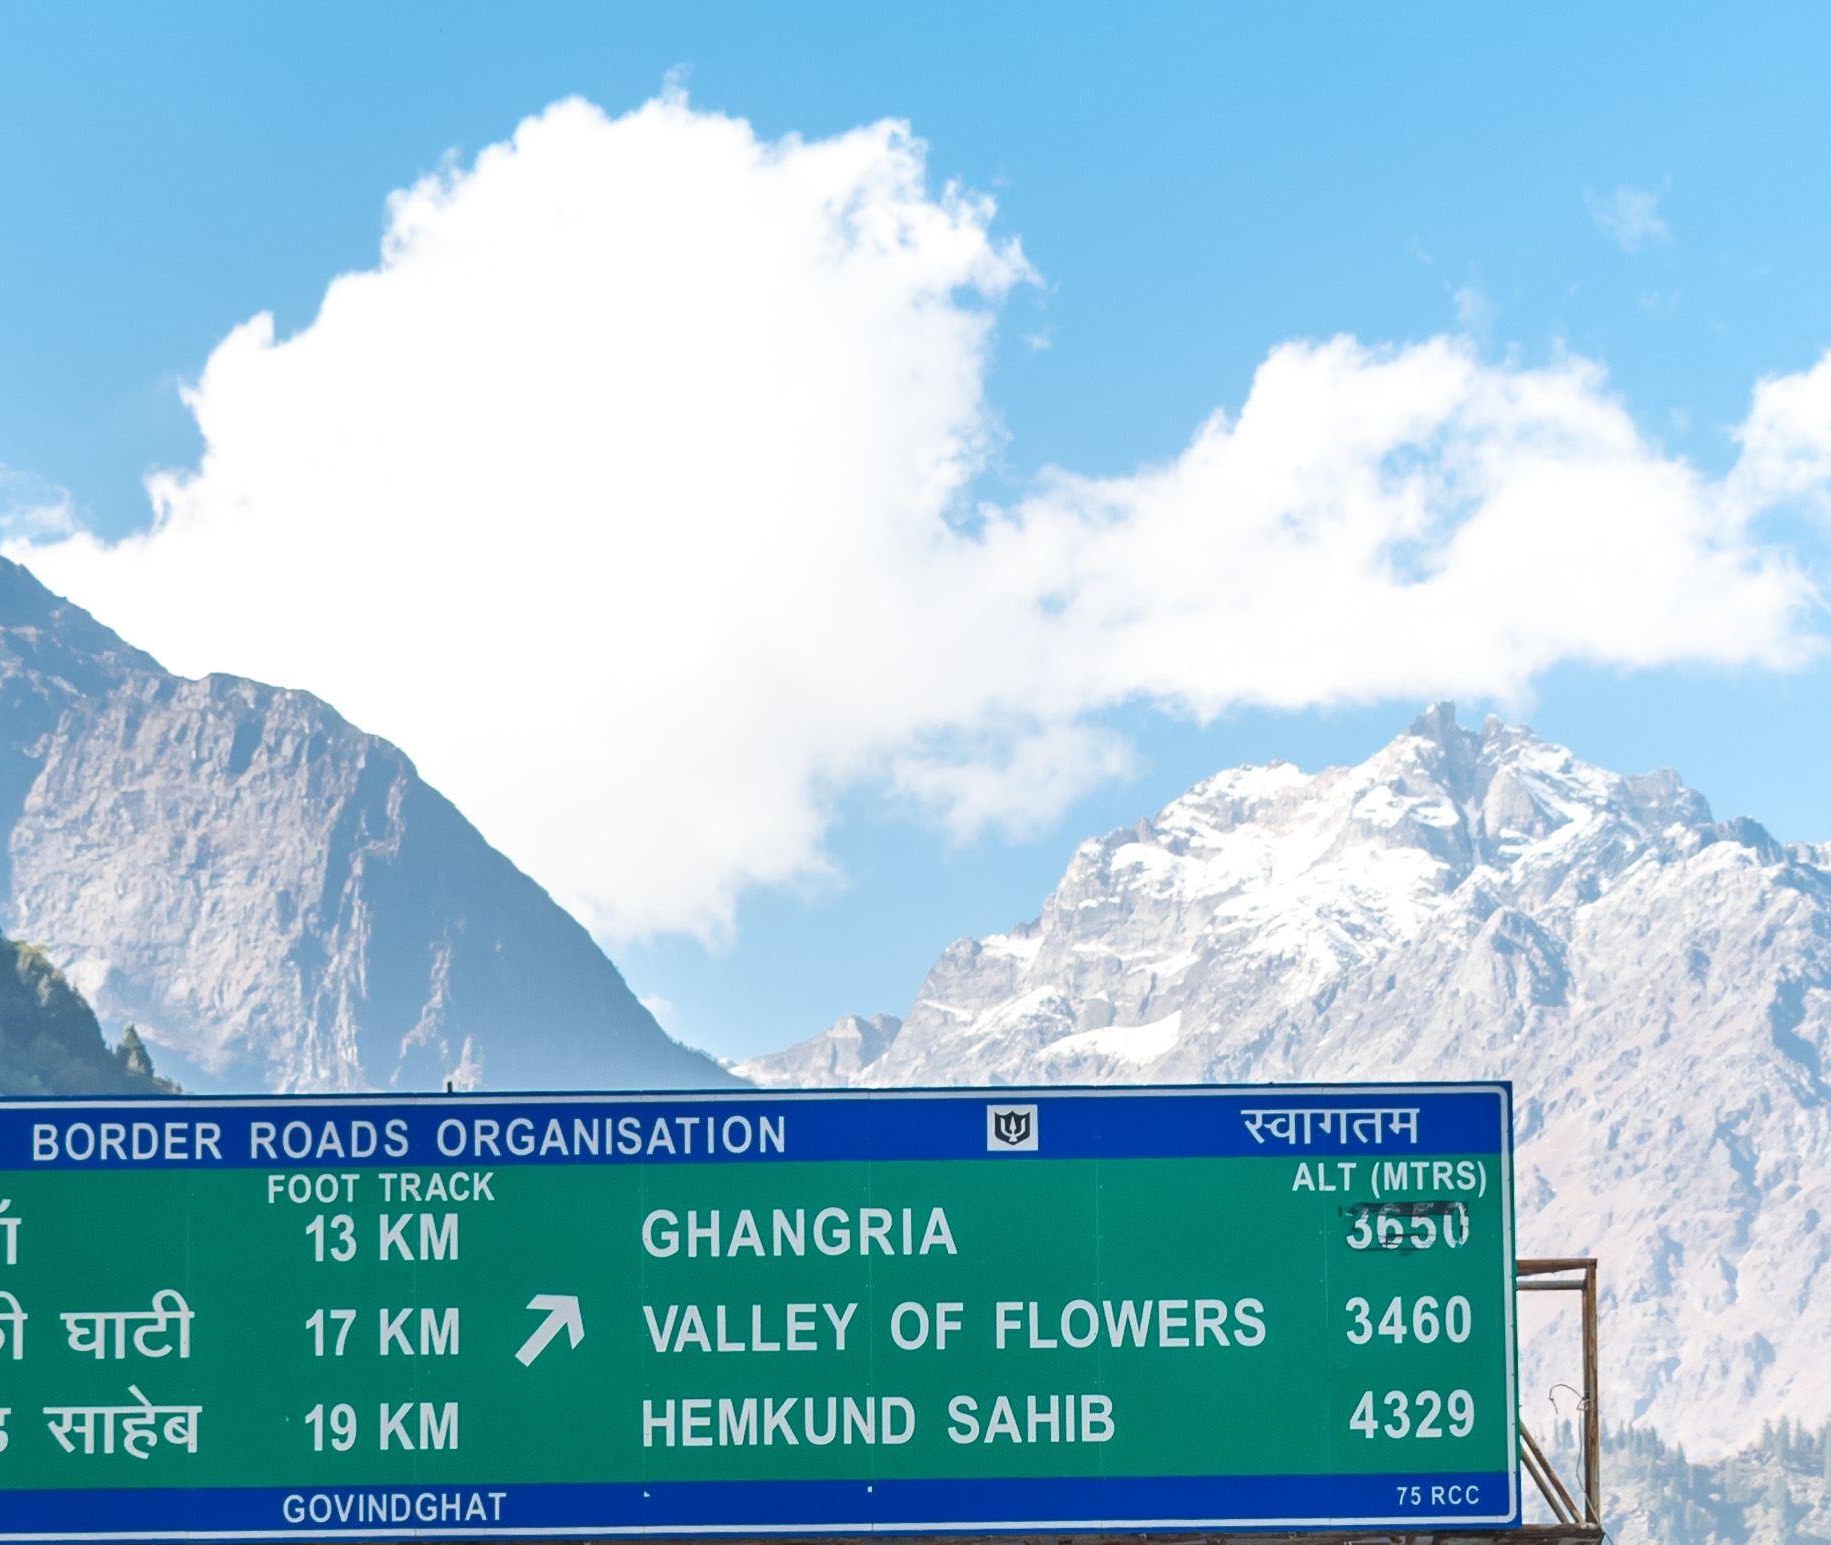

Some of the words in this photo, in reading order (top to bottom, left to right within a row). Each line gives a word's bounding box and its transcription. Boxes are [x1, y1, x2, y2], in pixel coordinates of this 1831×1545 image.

[33, 1122, 222, 1161] BORDER
[250, 1119, 409, 1159] ROADS
[437, 1115, 785, 1157] ORGANISATION
[1240, 1108, 1420, 1145] स्वागतम
[268, 1173, 360, 1204] FOOT
[378, 1171, 495, 1202] TRACK
[1292, 1162, 1357, 1192] ALT
[1371, 1160, 1487, 1199] (MTRS)
[305, 1214, 357, 1262] 13
[379, 1213, 459, 1261] KM
[642, 1206, 958, 1258] GHANGRIA
[59, 1288, 195, 1360] घाटी
[305, 1309, 357, 1357] 17
[379, 1307, 460, 1356] KM
[642, 1302, 858, 1353] VALLEY
[890, 1301, 964, 1351] OF
[996, 1297, 1266, 1349] FLOWERS
[1345, 1295, 1472, 1345] 3460
[42, 1384, 203, 1460] साहेब
[305, 1403, 357, 1452] 19
[379, 1402, 459, 1451] KM
[642, 1396, 916, 1447] HEMKUND
[947, 1394, 1115, 1444] SAHIB
[1349, 1389, 1475, 1439] 4329
[283, 1492, 507, 1524] GOVINDGHAT
[1396, 1486, 1422, 1506] 75
[1431, 1485, 1479, 1505] RCC
